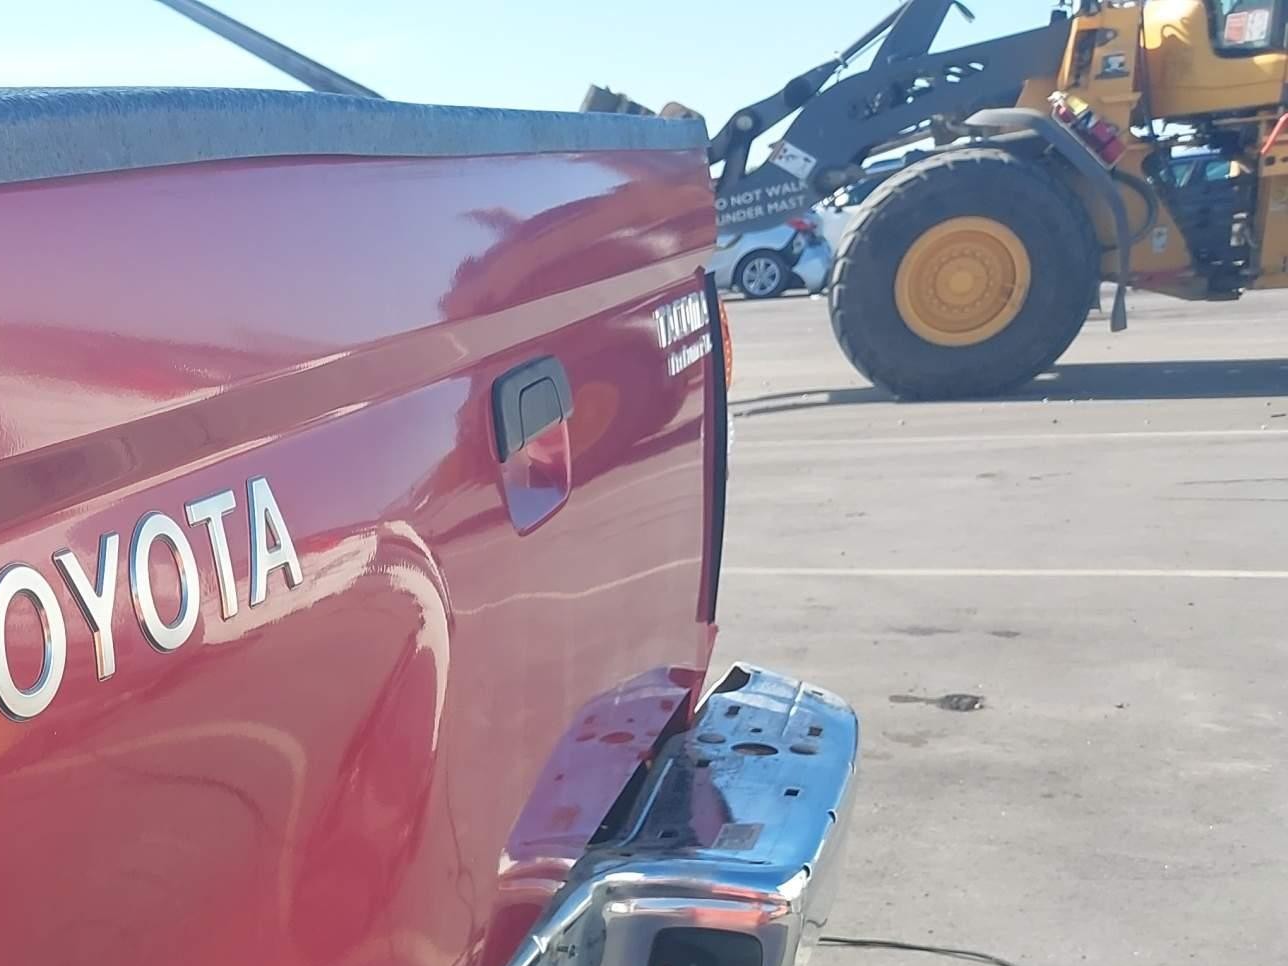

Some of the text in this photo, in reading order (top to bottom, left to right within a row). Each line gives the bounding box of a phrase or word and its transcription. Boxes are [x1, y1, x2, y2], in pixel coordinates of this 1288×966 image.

[715, 180, 809, 212] O NOT WALK
[716, 195, 805, 226] UNDER MAST
